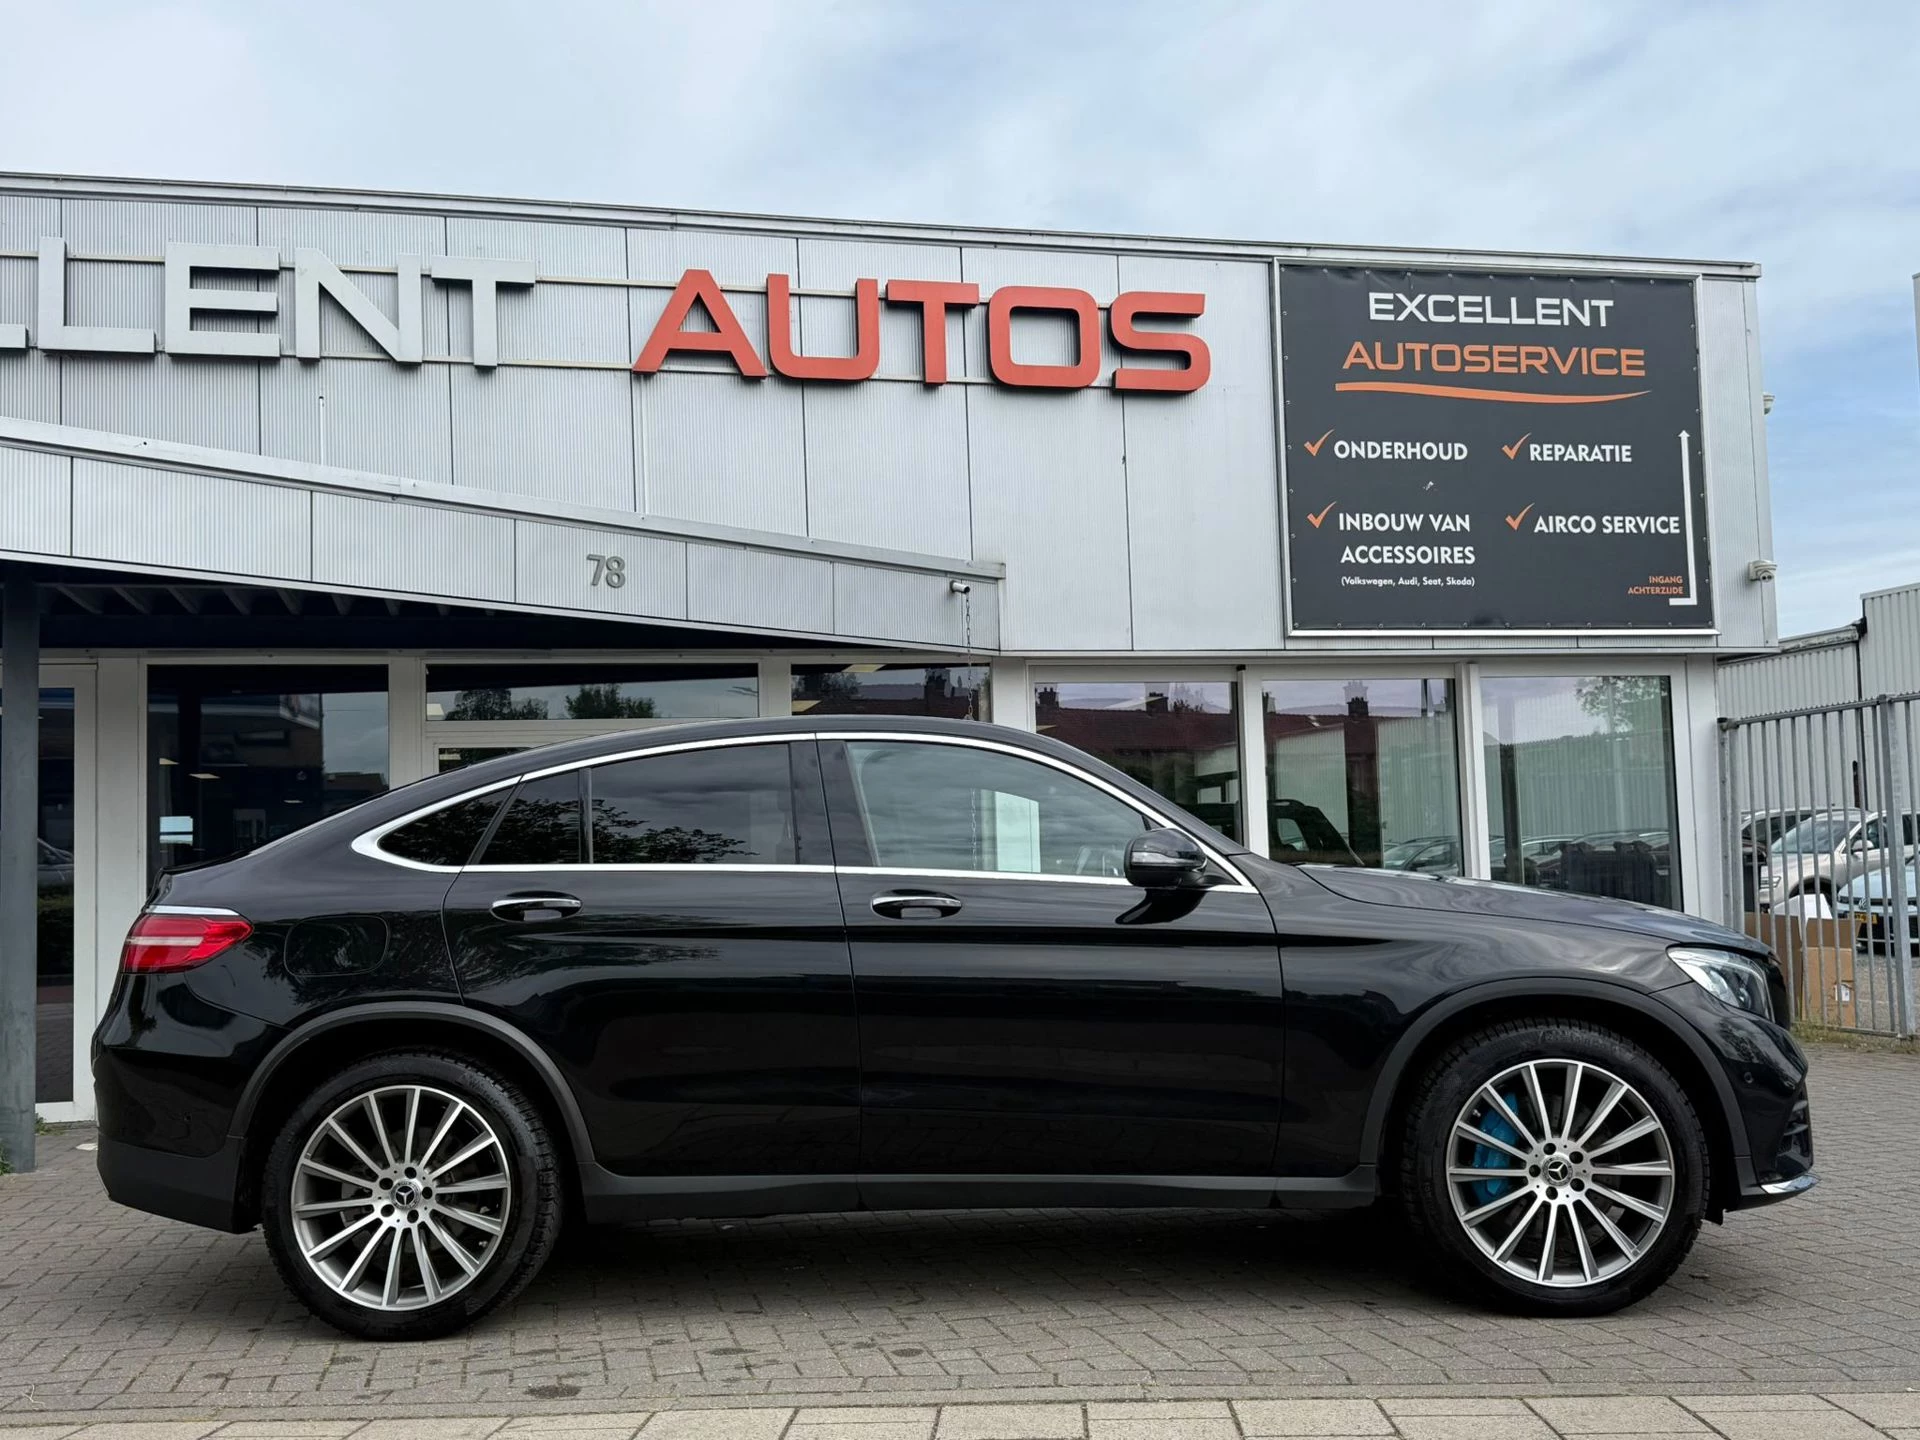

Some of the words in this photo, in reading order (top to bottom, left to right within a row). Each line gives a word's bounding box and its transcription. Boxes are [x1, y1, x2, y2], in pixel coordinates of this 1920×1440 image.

[0, 236, 536, 367] LENT
[633, 269, 1211, 392] AUTOS
[1368, 291, 1615, 328] EXCELLENT
[1342, 341, 1647, 377] AUTOSERVICE
[1333, 439, 1468, 461] ONDERHOUD
[1529, 443, 1633, 463] REPARATIE
[1338, 512, 1424, 532] INBOUW
[1428, 513, 1471, 533] VAN
[1533, 514, 1598, 534] AIRCO
[1601, 515, 1681, 535] SERVICE
[1340, 544, 1476, 565] ACCESSOIRES
[586, 554, 626, 588] 78
[1648, 575, 1683, 584] INGANG
[1340, 576, 1396, 588] (Volkswagen,
[1397, 576, 1421, 587] Audi,
[1422, 576, 1445, 587] Seat,
[1446, 576, 1476, 588] Skoda)
